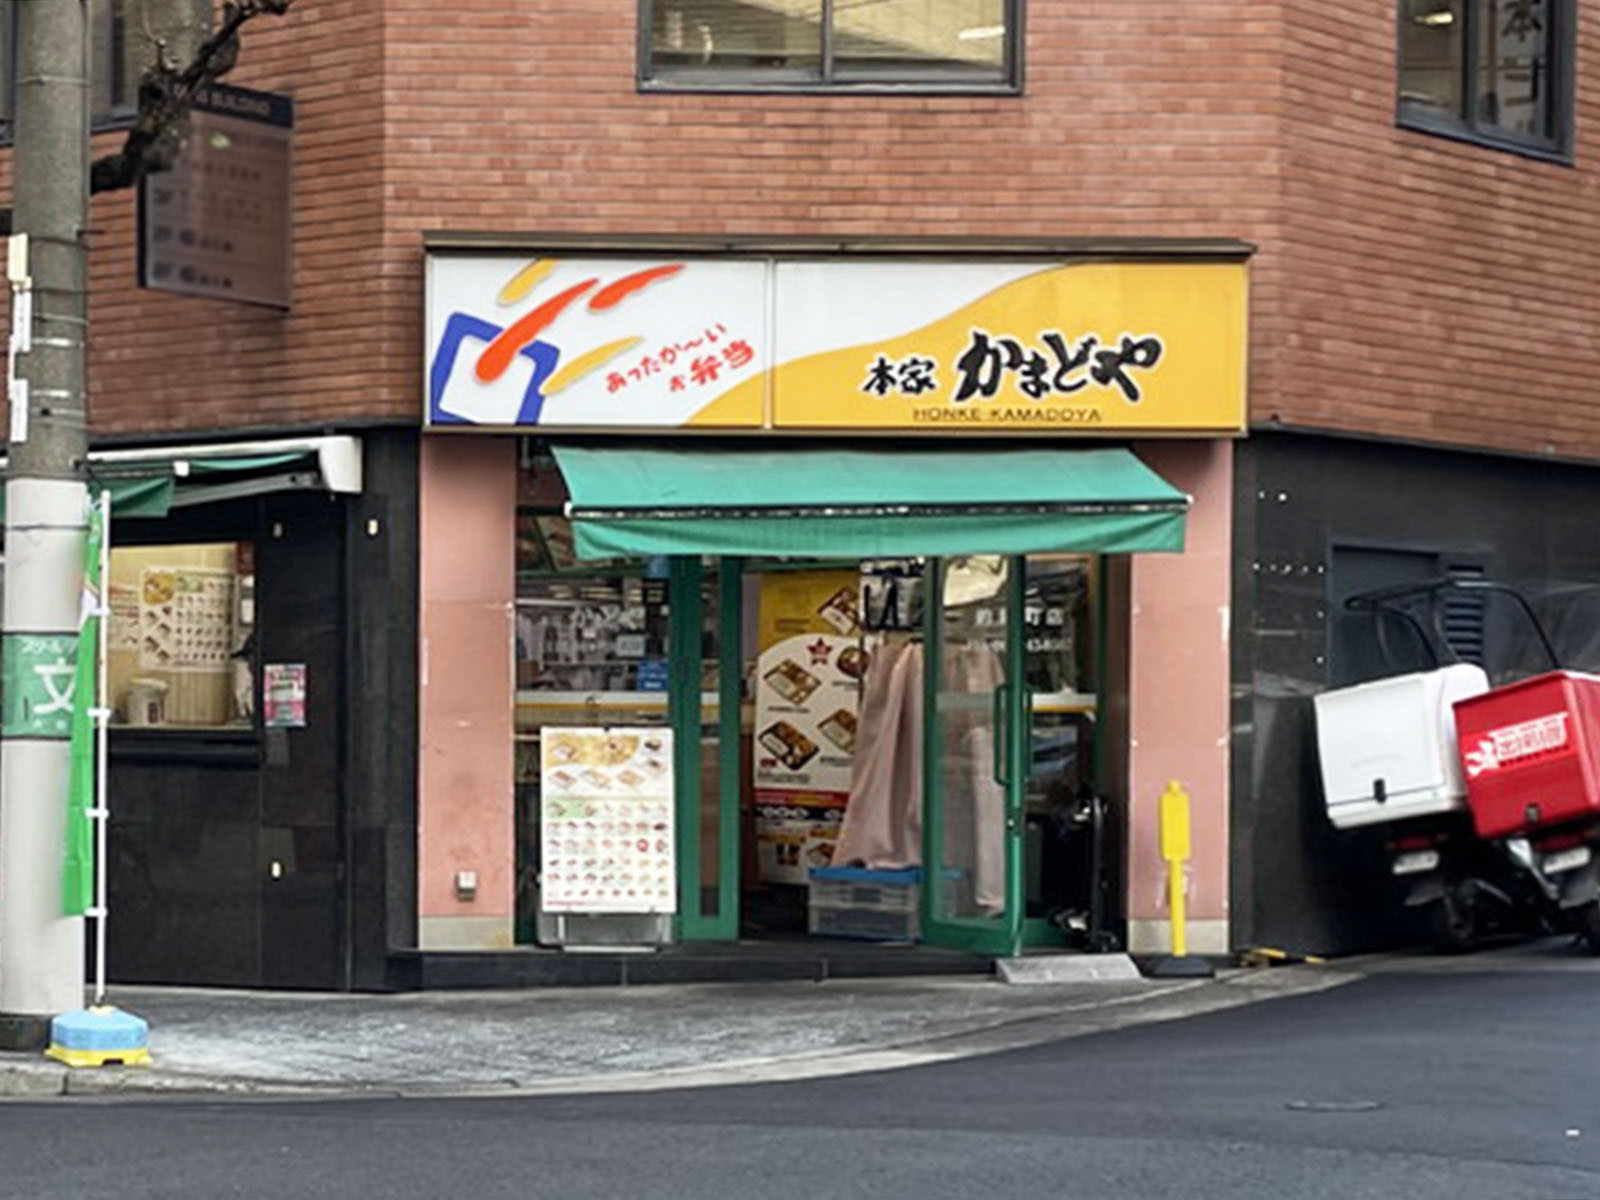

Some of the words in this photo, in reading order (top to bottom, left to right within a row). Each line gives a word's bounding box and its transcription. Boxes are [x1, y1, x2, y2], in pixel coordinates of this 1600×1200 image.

[670, 340, 755, 392] お弁当
[862, 356, 936, 395] 本家
[953, 330, 1162, 402] かまどや
[913, 407, 981, 422] HONKE
[990, 408, 1101, 422] KAMADOYA
